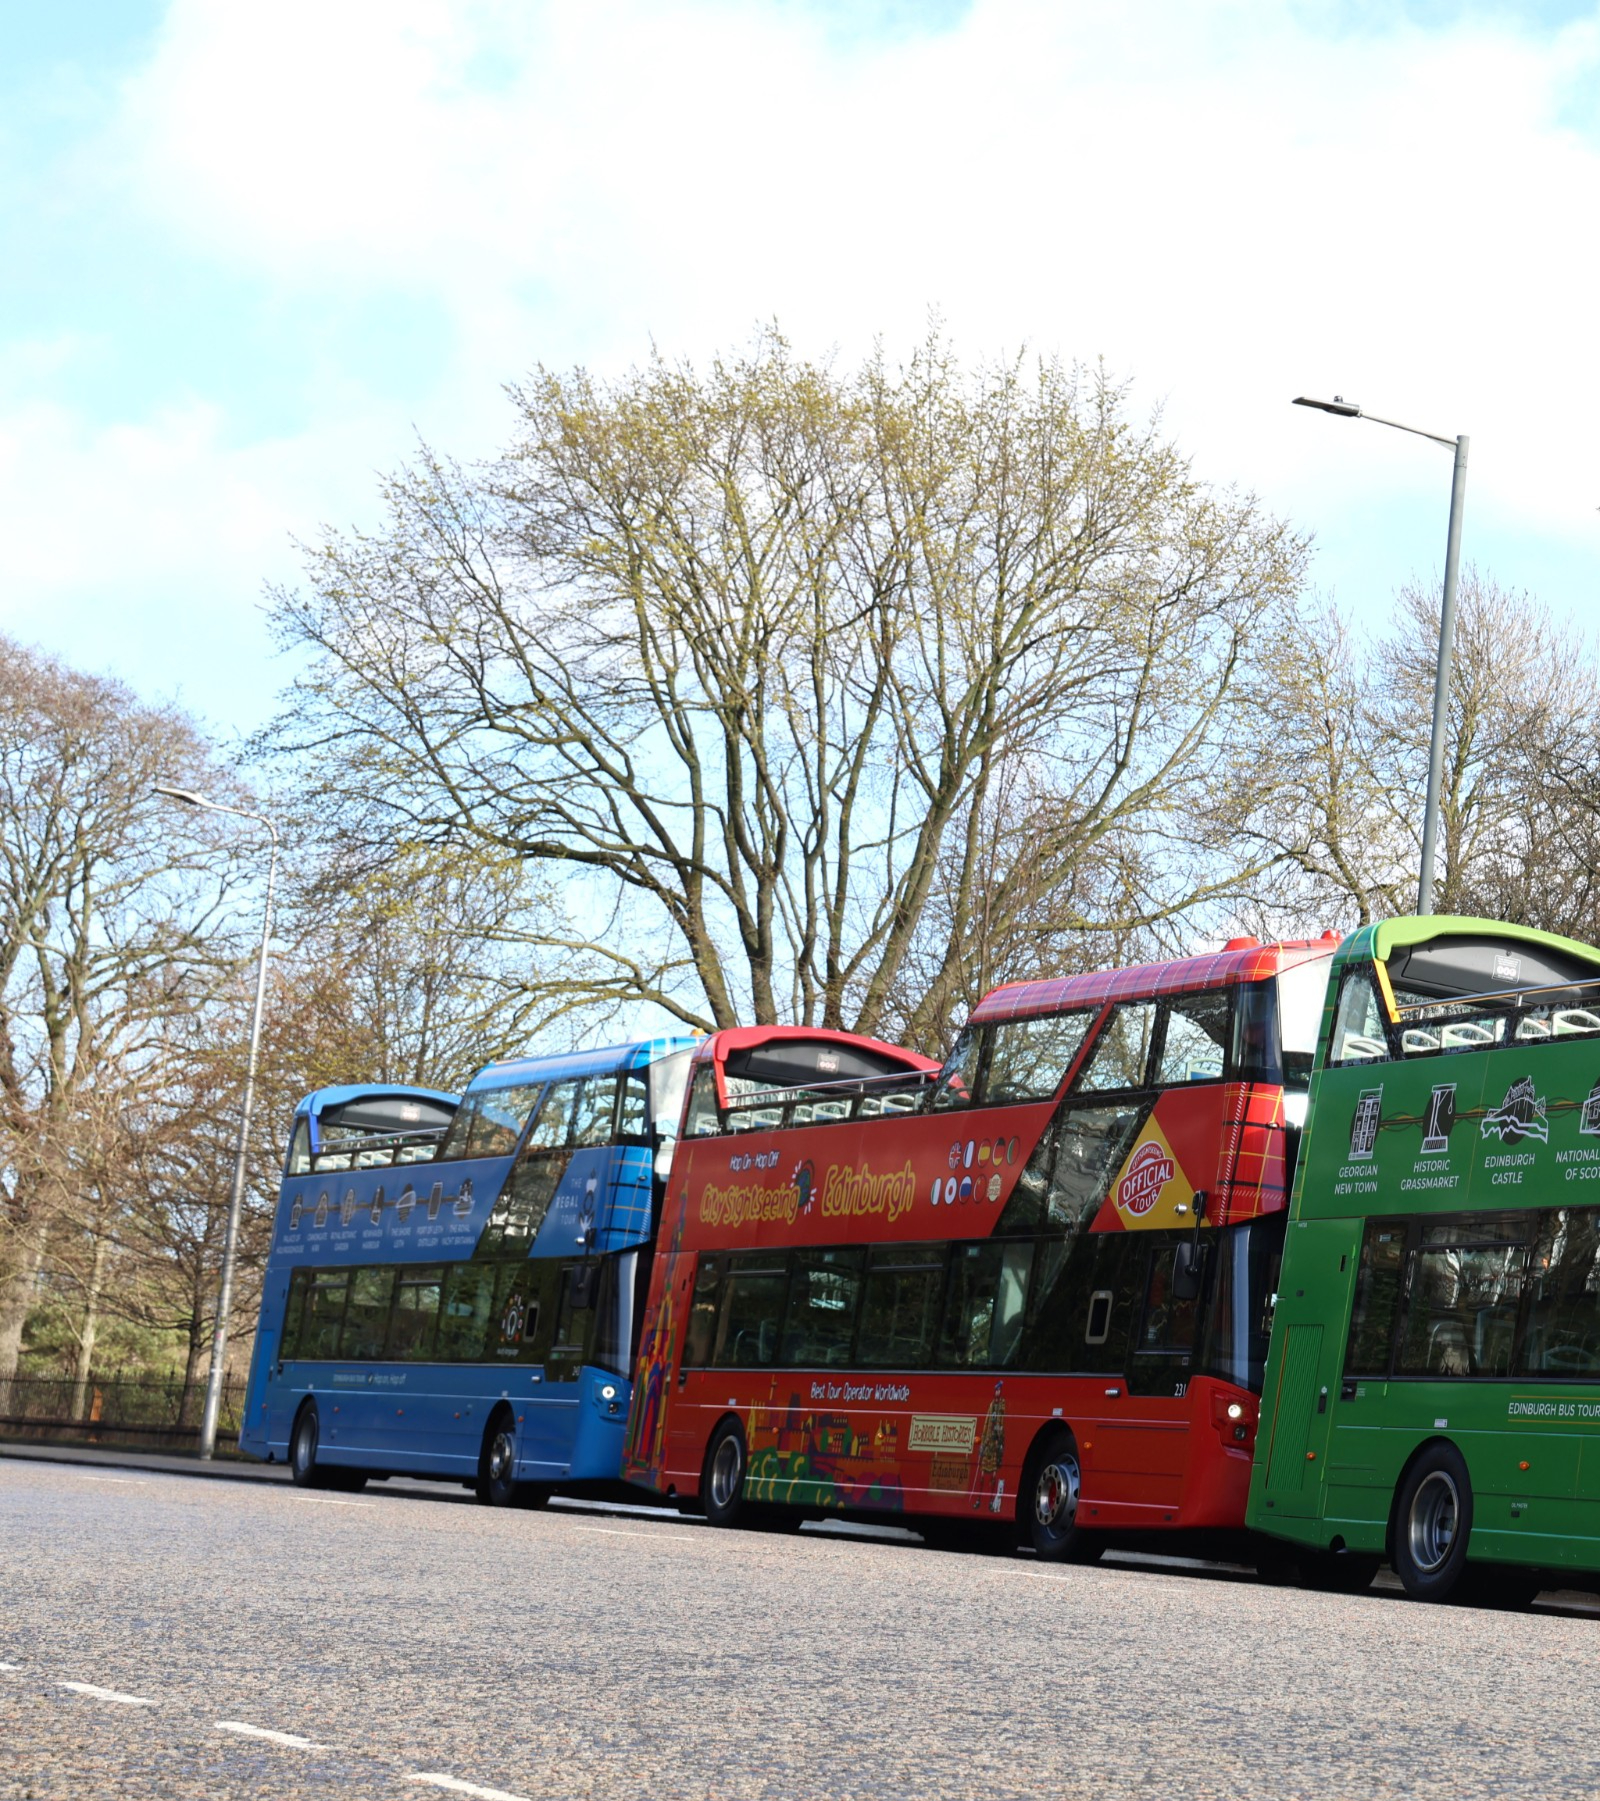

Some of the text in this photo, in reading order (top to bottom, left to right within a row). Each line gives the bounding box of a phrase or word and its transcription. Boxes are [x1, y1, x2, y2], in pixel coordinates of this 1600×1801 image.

[729, 1154, 742, 1171] Hop
[755, 1152, 767, 1169] Hop
[768, 1150, 780, 1168] Off
[1484, 1153, 1536, 1169] EDINBURGH
[1555, 1148, 1600, 1163] NATIONAL
[1338, 1164, 1379, 1178] GEORGIAN
[1413, 1159, 1451, 1173] HISTORIC
[1122, 1161, 1172, 1201] OFFICIAL
[1491, 1171, 1524, 1185] CASTLE
[1565, 1167, 1578, 1181] OF
[1334, 1181, 1378, 1195] NEW TOWN
[1400, 1175, 1460, 1191] GRASSMARKET
[820, 1159, 916, 1223] Edinburgh
[555, 1194, 579, 1209] REGAL
[1135, 1188, 1158, 1211] TOUR
[811, 1381, 910, 1402] Best Tour Operator Worldwide
[1174, 1383, 1187, 1397] 231
[1507, 1402, 1557, 1416] EDINBURGH
[1558, 1403, 1575, 1417] BUS
